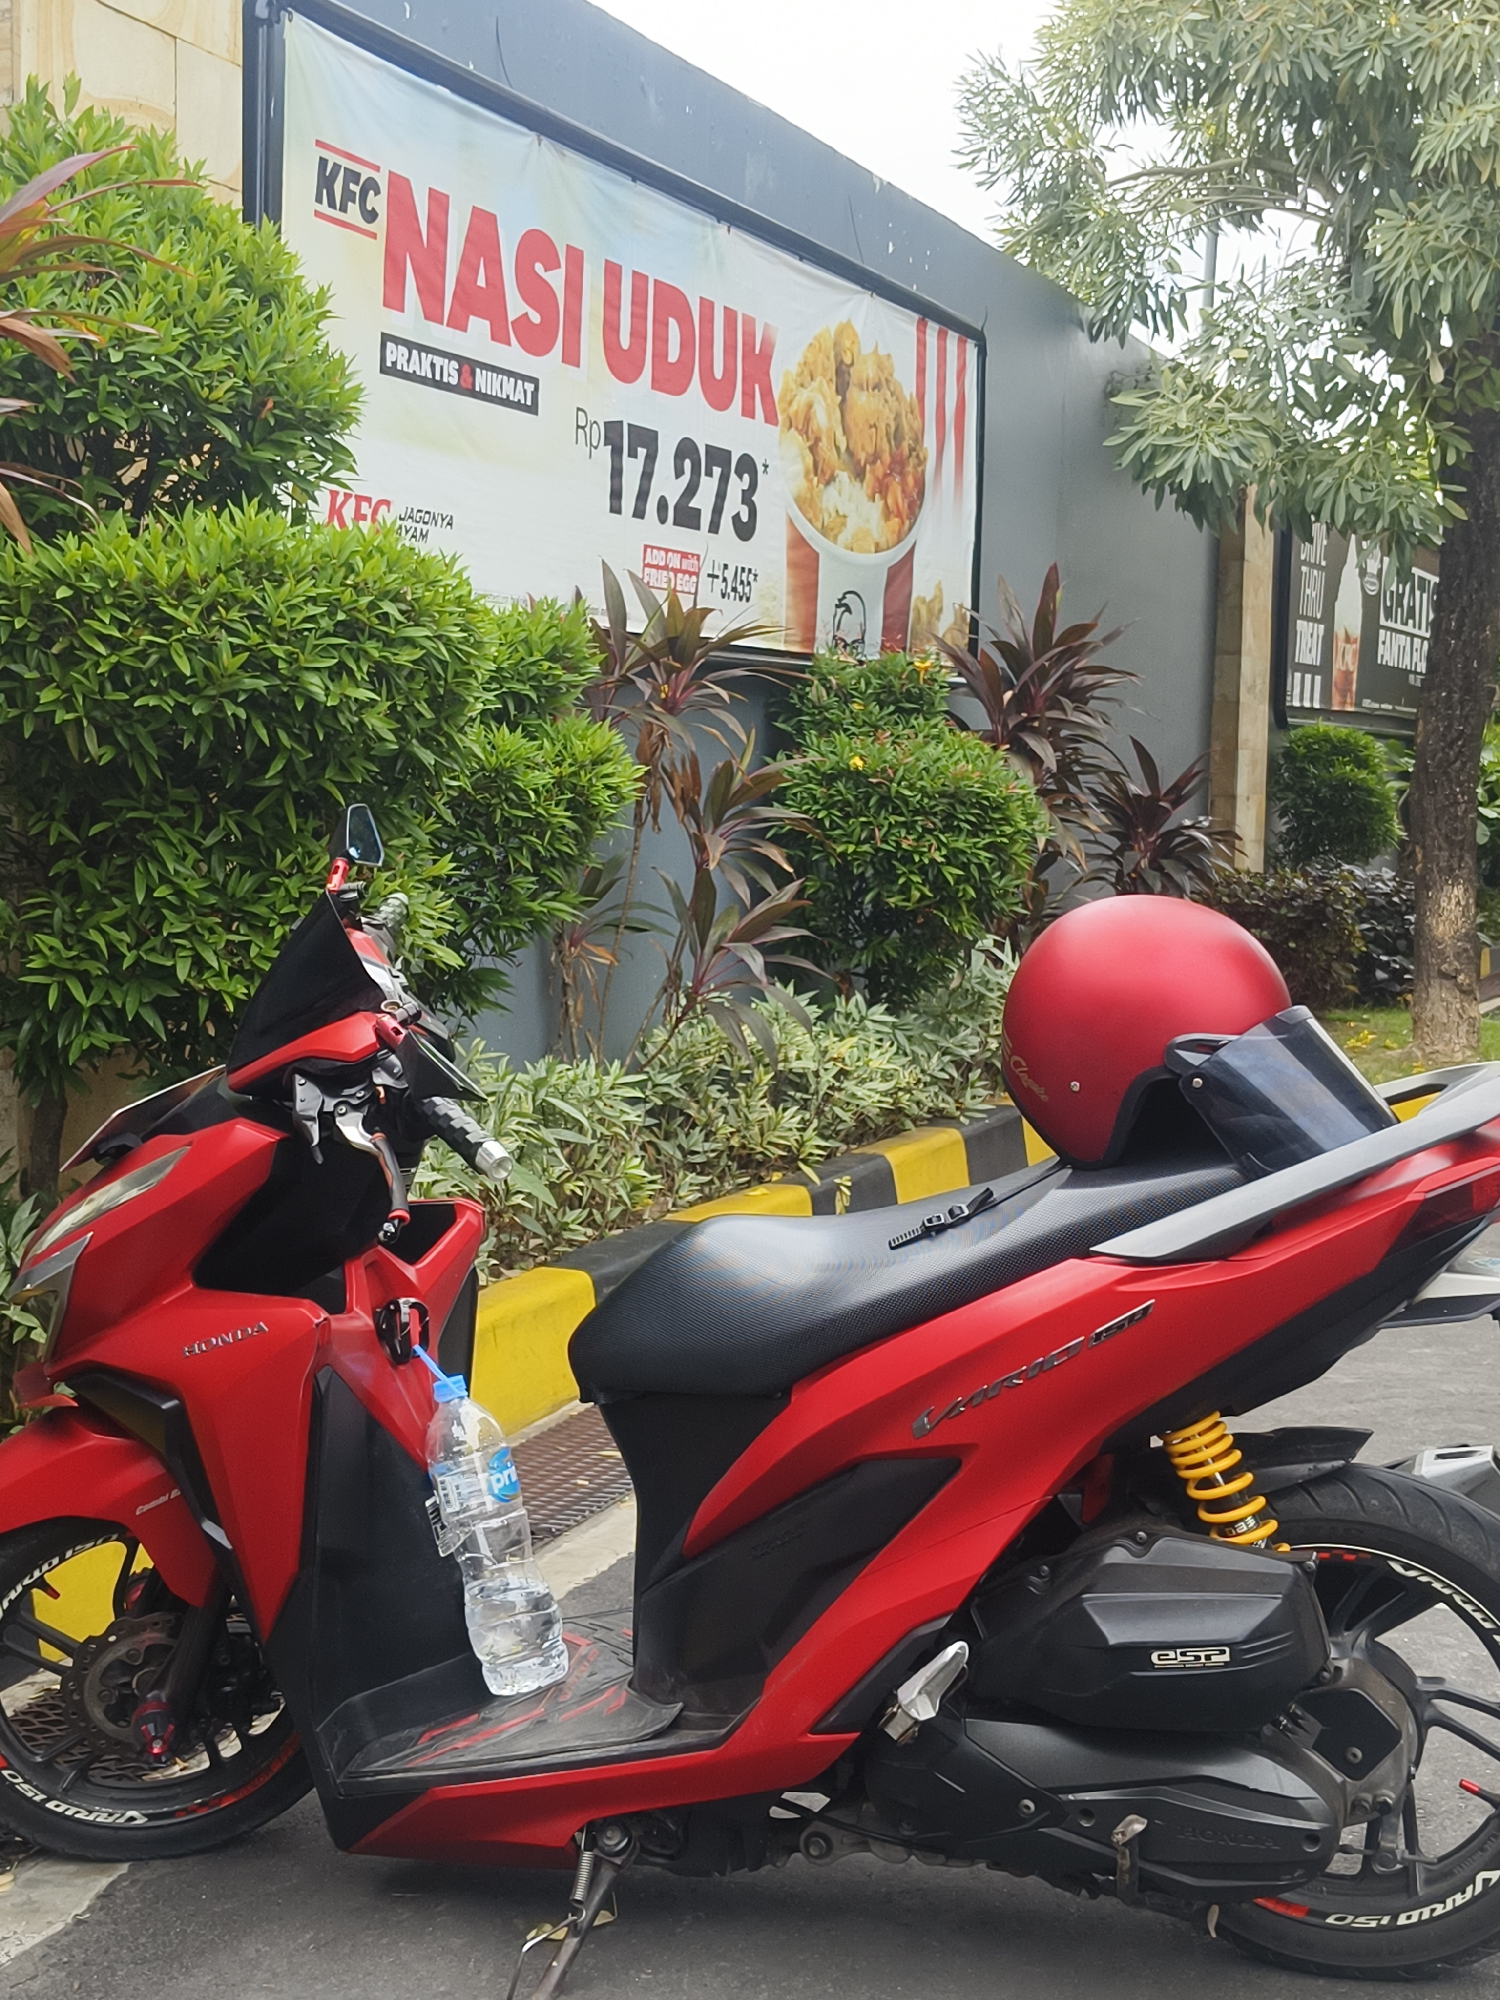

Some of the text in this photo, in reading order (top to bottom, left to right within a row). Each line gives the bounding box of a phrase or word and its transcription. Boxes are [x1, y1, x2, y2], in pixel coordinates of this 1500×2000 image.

[314, 155, 381, 225] KFC
[382, 169, 780, 428] NASI UDUK
[385, 341, 535, 407] PRAKTIS & NIKMAT
[575, 406, 601, 460] Rp
[395, 523, 430, 543] AYAM
[398, 506, 454, 530] JAGONYA
[643, 566, 698, 593] FRIED EGG
[645, 547, 666, 567] ADD
[666, 551, 682, 569] ON
[1299, 566, 1325, 619] THRU
[1295, 620, 1325, 666] TREAT
[1377, 629, 1411, 671] FANTA
[182, 1321, 270, 1358] HONDA
[1, 1770, 149, 1825] VARIO 150
[1325, 1869, 1500, 1928] VARIO 150
